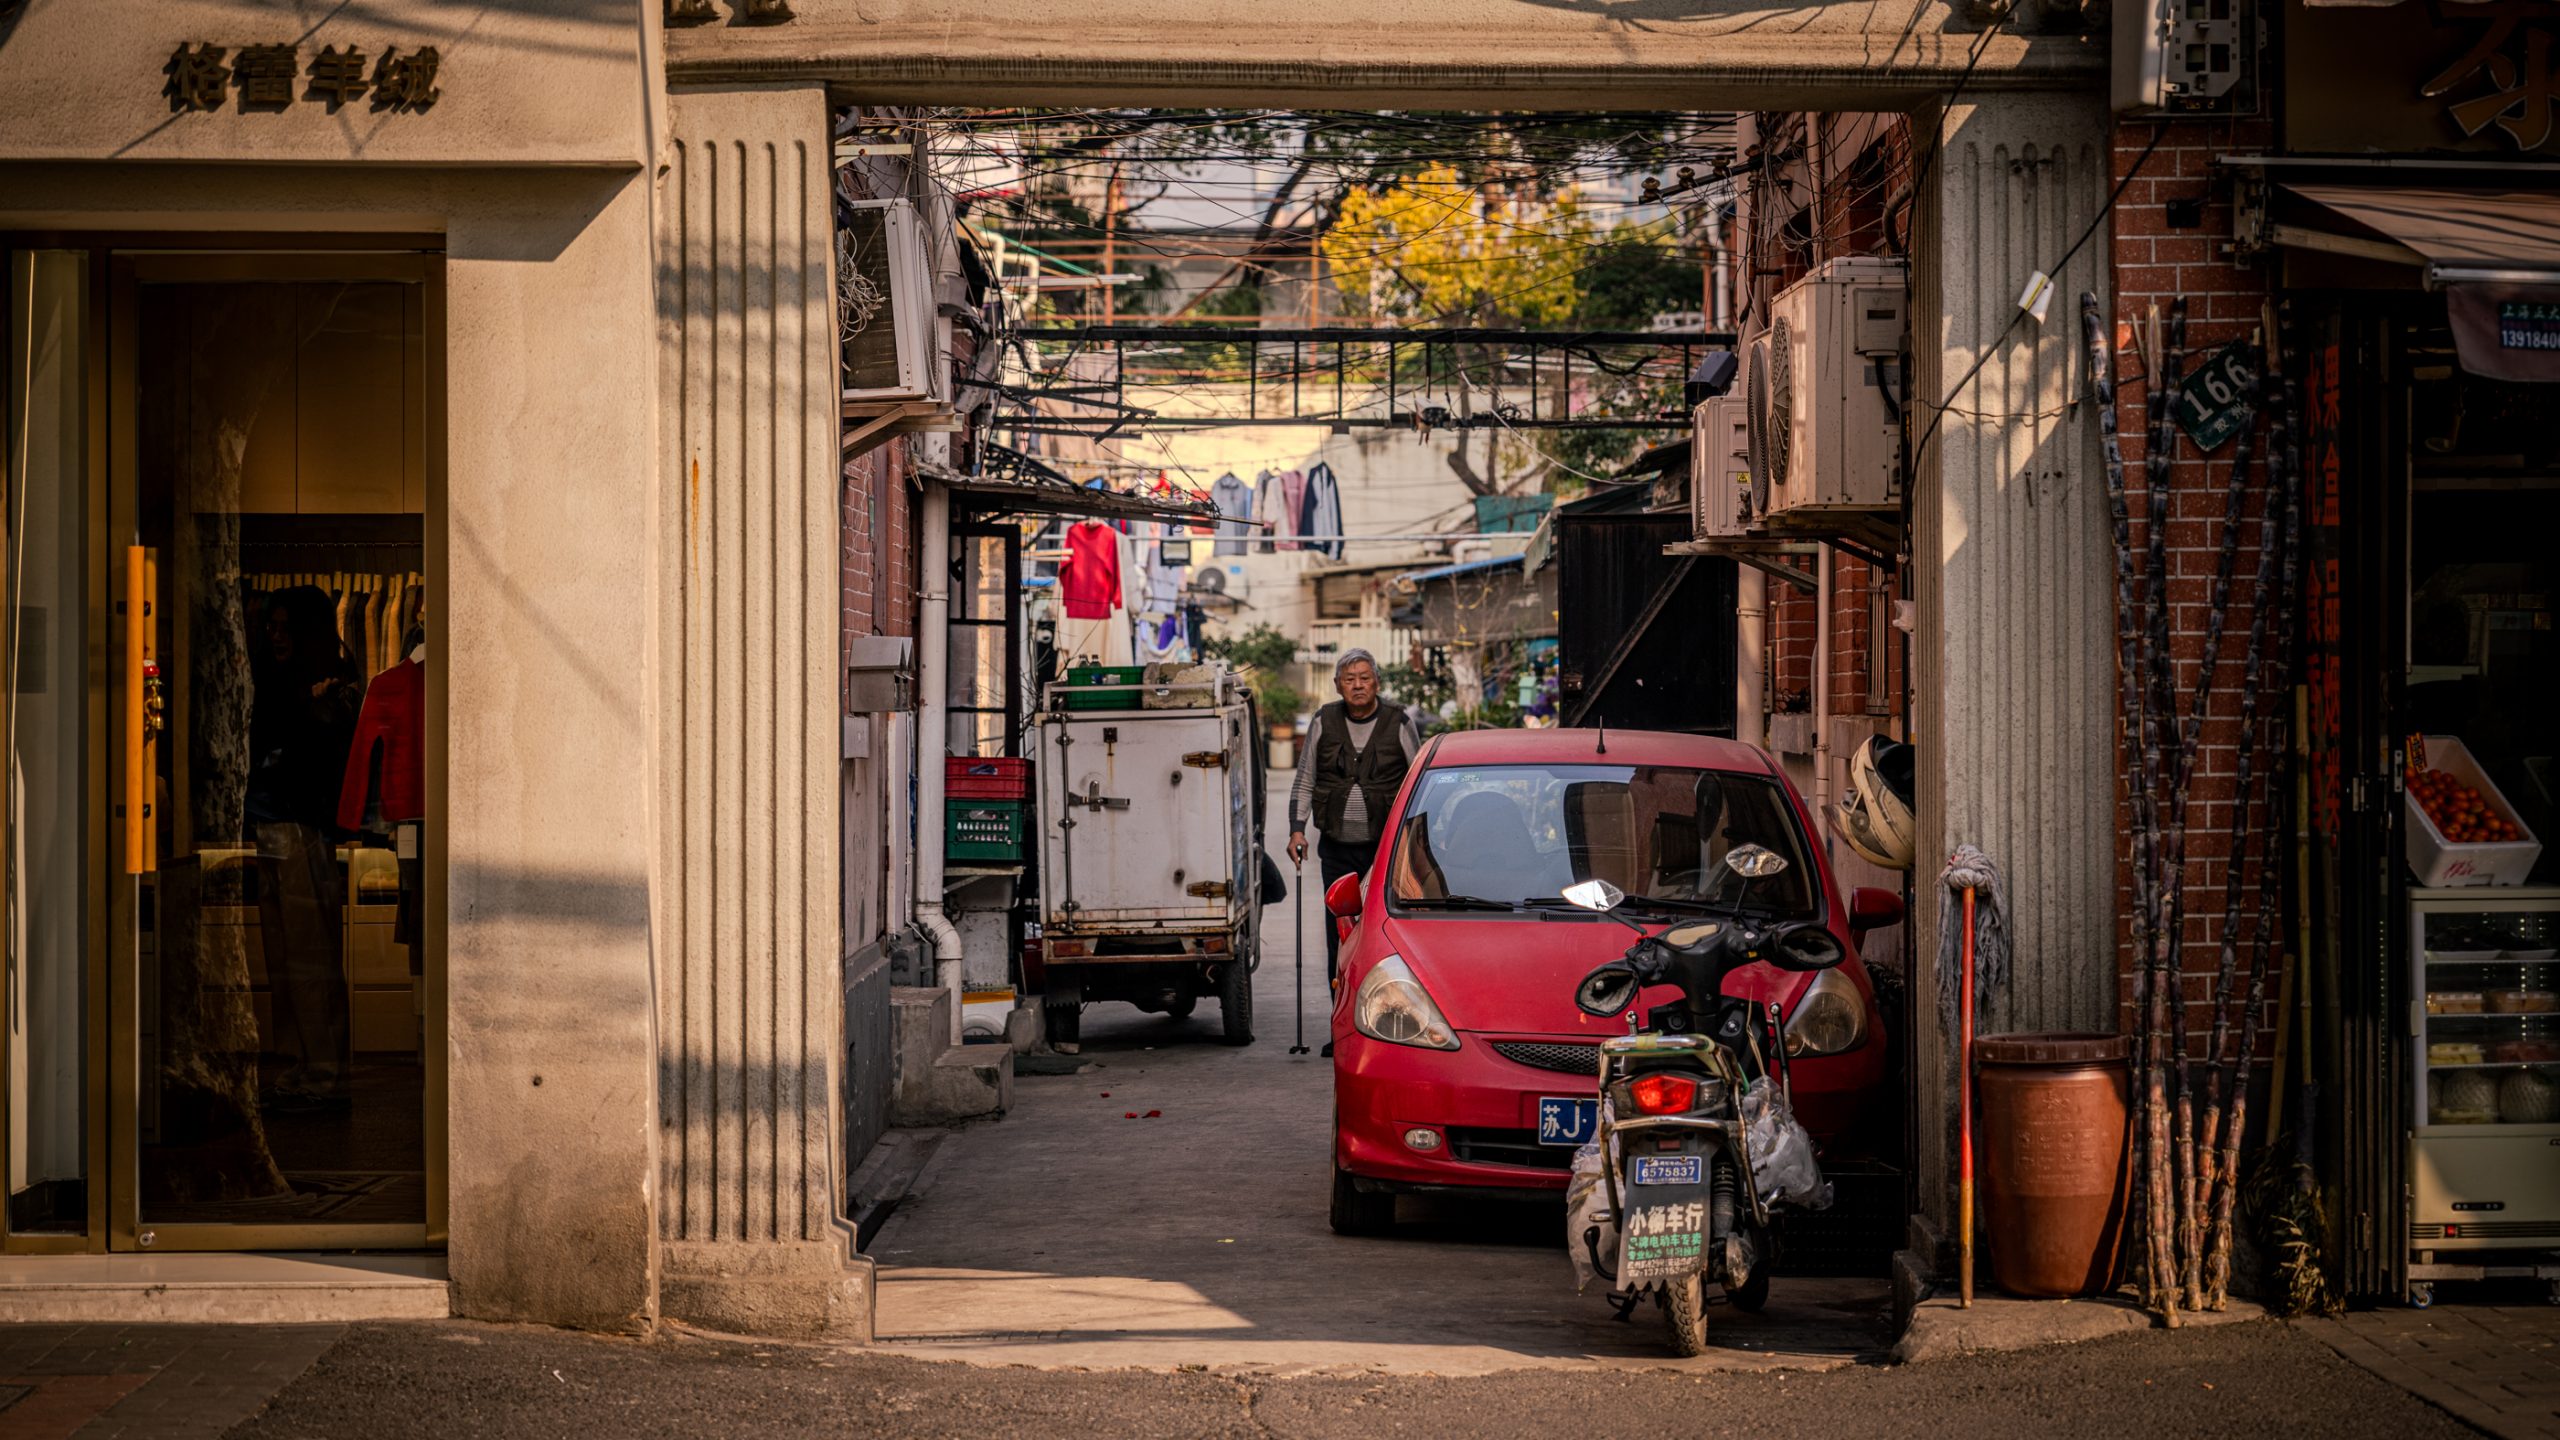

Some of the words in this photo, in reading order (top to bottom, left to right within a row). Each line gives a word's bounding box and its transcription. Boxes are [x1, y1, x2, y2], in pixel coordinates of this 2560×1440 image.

[166, 42, 441, 111] 格蕾羊绒
[2184, 355, 2249, 422] 166
